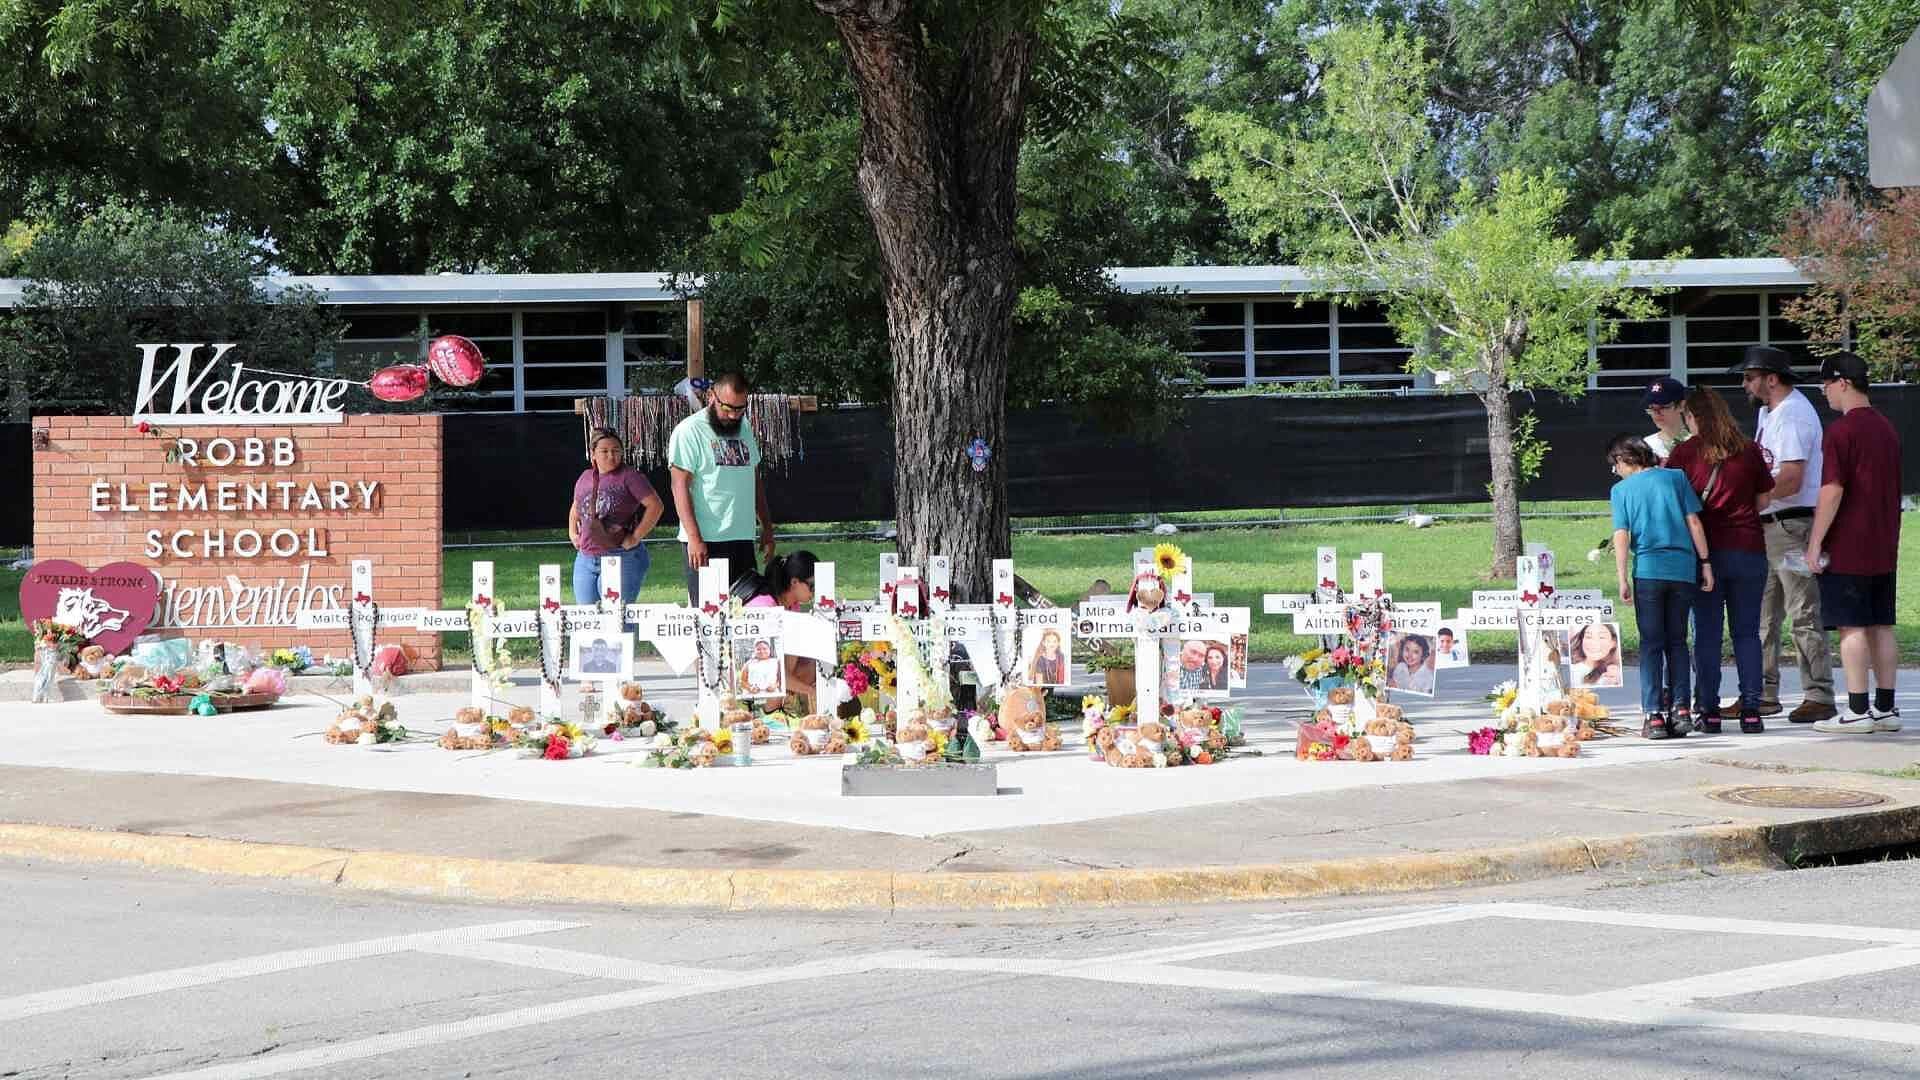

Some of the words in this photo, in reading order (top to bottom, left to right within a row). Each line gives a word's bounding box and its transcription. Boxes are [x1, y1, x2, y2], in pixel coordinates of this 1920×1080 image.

[133, 343, 348, 415] Welcome
[177, 437, 297, 467] ROBB
[91, 479, 379, 513] ELEMENTARY
[144, 528, 329, 558] SCHOOL
[312, 613, 350, 625] Maite
[656, 623, 694, 637] Ellie
[701, 623, 760, 637] Garcia
[1470, 613, 1519, 626] Jackie
[1525, 613, 1594, 627] Cazares
